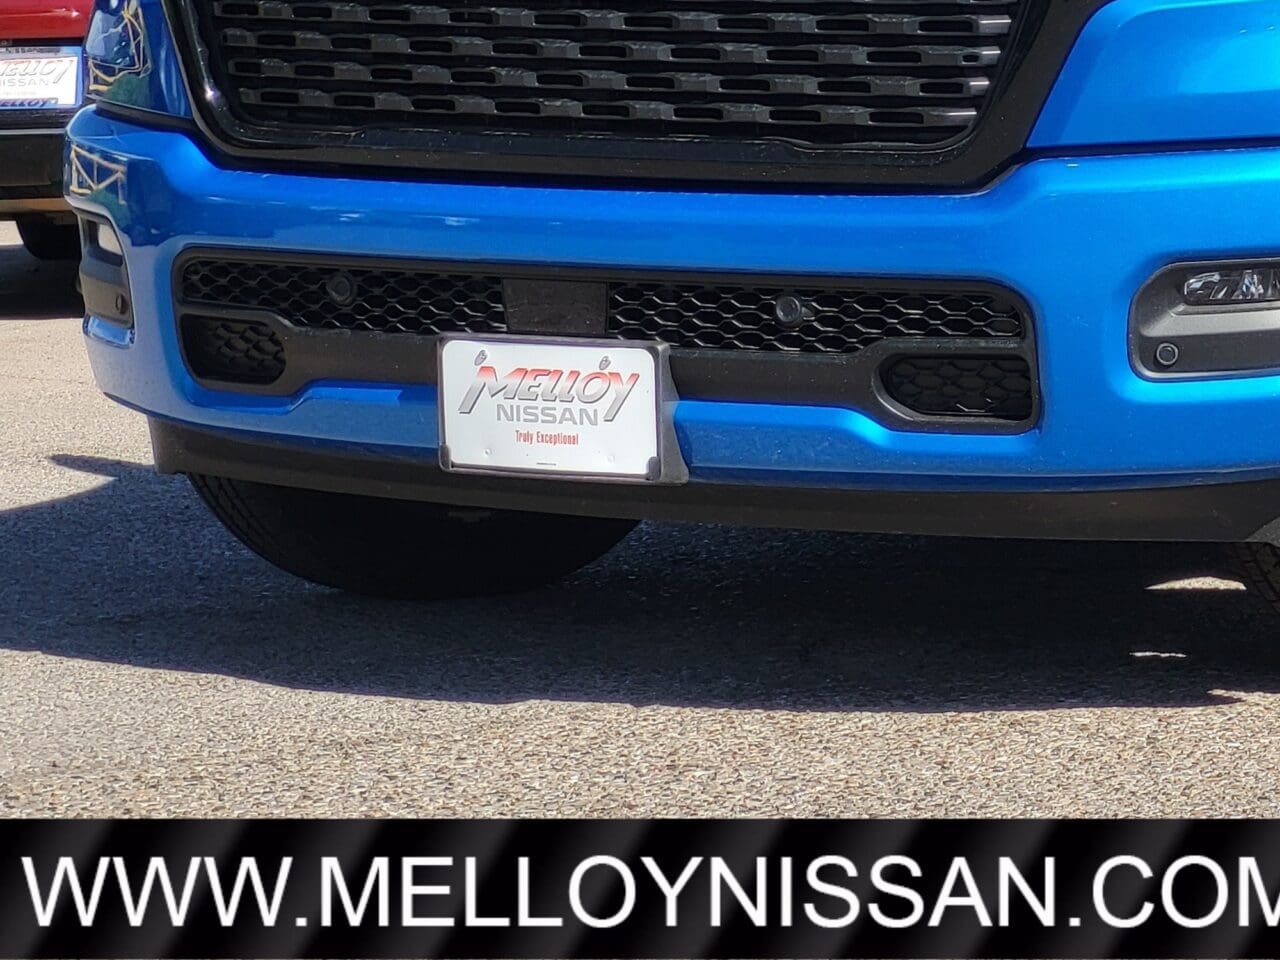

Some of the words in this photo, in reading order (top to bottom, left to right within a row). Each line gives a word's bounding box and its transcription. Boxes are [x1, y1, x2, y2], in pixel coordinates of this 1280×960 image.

[0, 59, 74, 84] ELLOY
[0, 78, 49, 87] ISSAN
[458, 365, 640, 423] MELLOY
[496, 404, 598, 426] NISSAN
[515, 429, 534, 445] Truly
[536, 430, 579, 446] Exceptional
